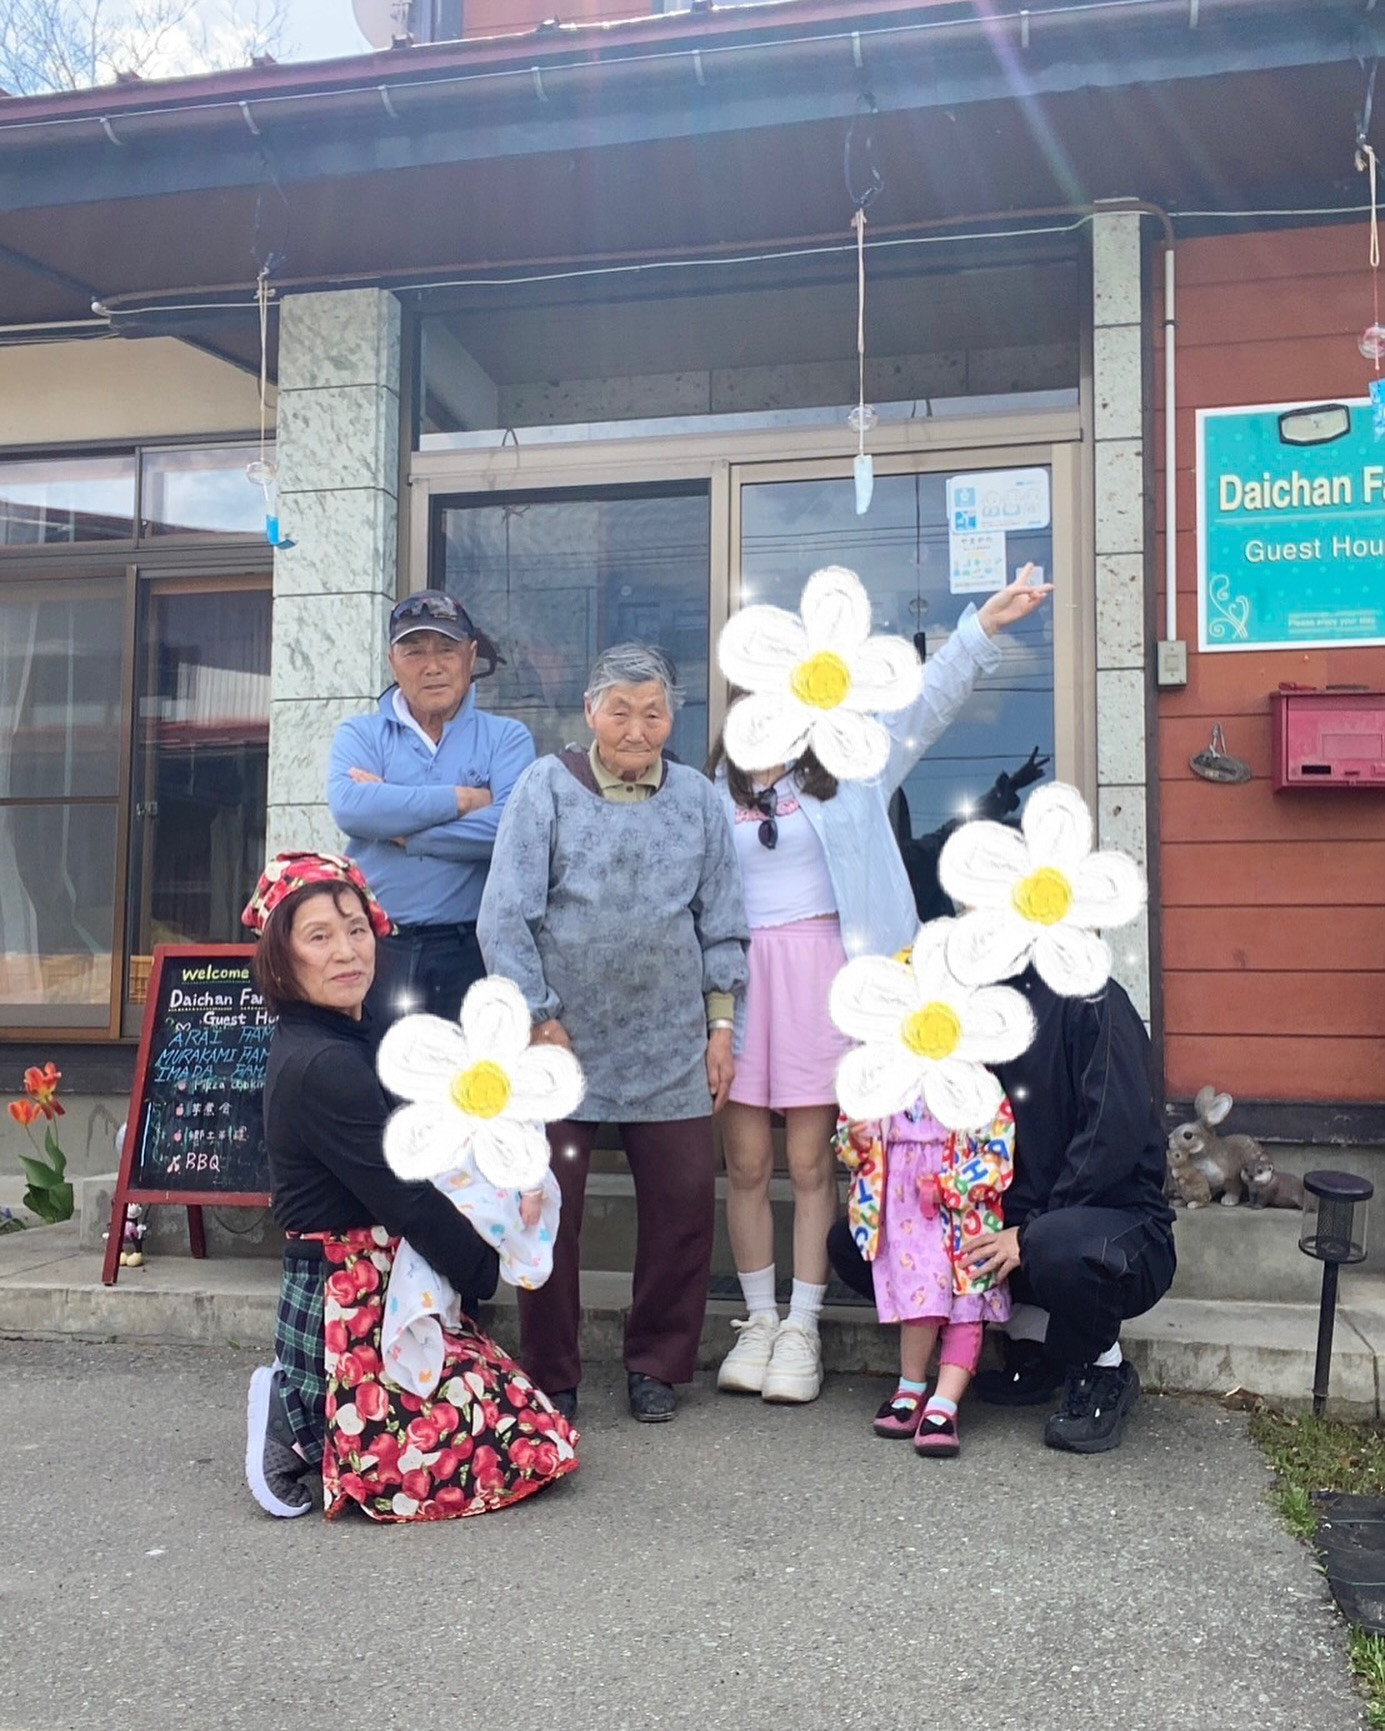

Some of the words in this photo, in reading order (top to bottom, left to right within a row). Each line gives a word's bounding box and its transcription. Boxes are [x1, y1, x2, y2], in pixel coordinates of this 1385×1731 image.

[1219, 471, 1352, 511] Daichan
[1363, 465, 1385, 503] F
[1246, 539, 1320, 562] Guest
[170, 989, 232, 1008] Daichan
[203, 1011, 247, 1026] Guest
[168, 1029, 222, 1047] ARAI
[155, 1047, 237, 1067] MURAKAMI
[154, 1064, 213, 1082] IMADA
[185, 1152, 220, 1172] BBQ
